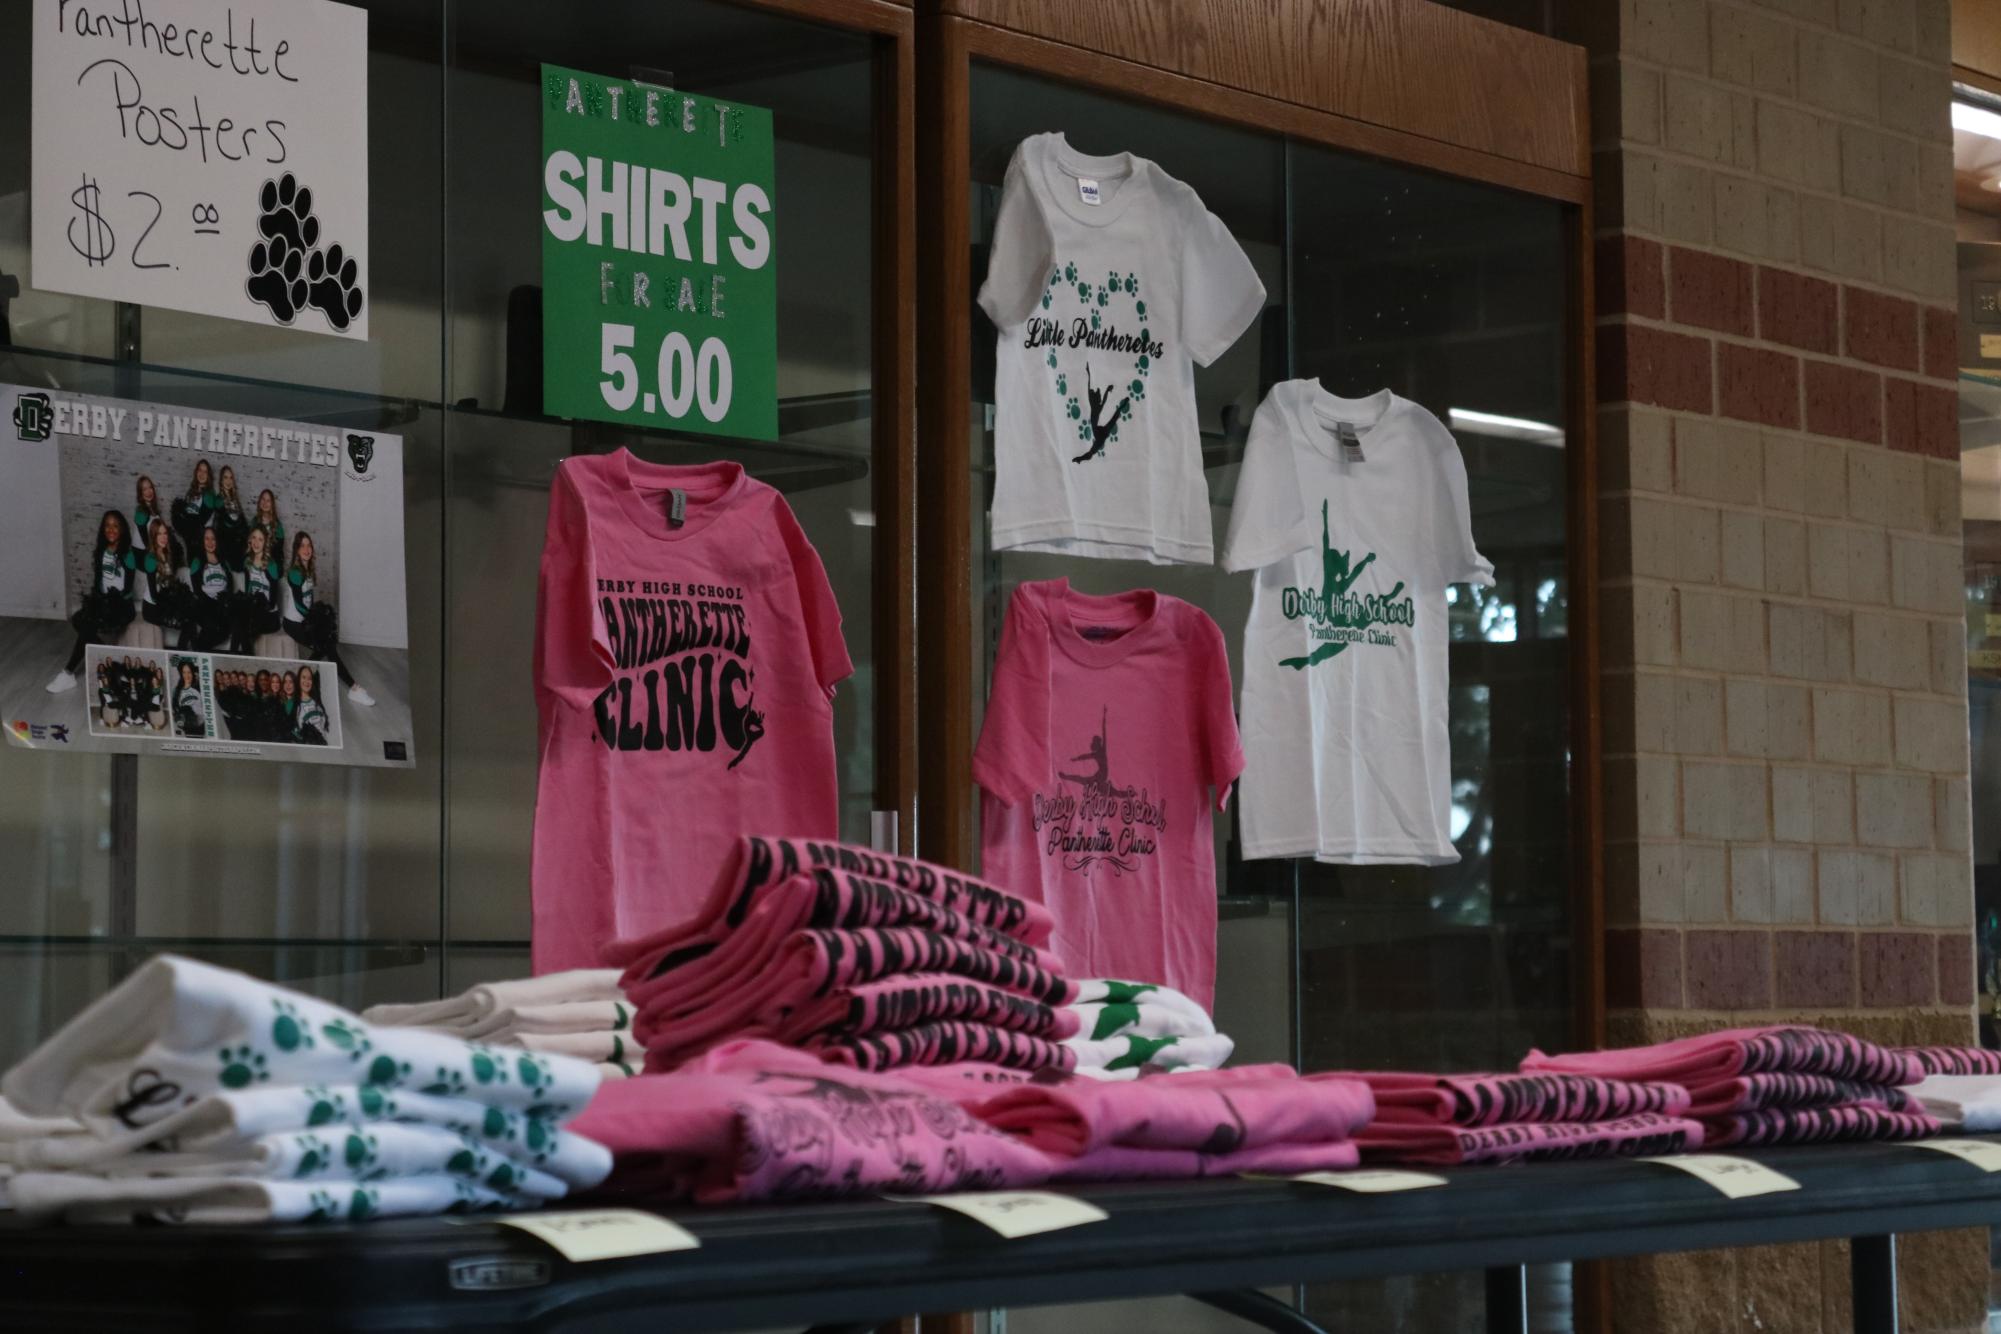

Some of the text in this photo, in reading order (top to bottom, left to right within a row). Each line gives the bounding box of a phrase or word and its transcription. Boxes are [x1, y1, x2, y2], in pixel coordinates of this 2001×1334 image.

[78, 59, 287, 163] Posters
[543, 150, 772, 270] SHIRTS
[664, 274, 726, 319] SALE
[600, 322, 733, 423] 5.00
[136, 411, 340, 467] PANTHERETTES
[597, 578, 744, 600] ERBY HIGH SCHOOL
[1331, 591, 1363, 623] High
[1364, 594, 1415, 628] School
[597, 596, 751, 670] ANTHERETTE
[1368, 628, 1398, 648] Clinic
[594, 652, 752, 752] CLINIC
[1080, 779, 1118, 823] High
[1117, 827, 1157, 857] Clinic
